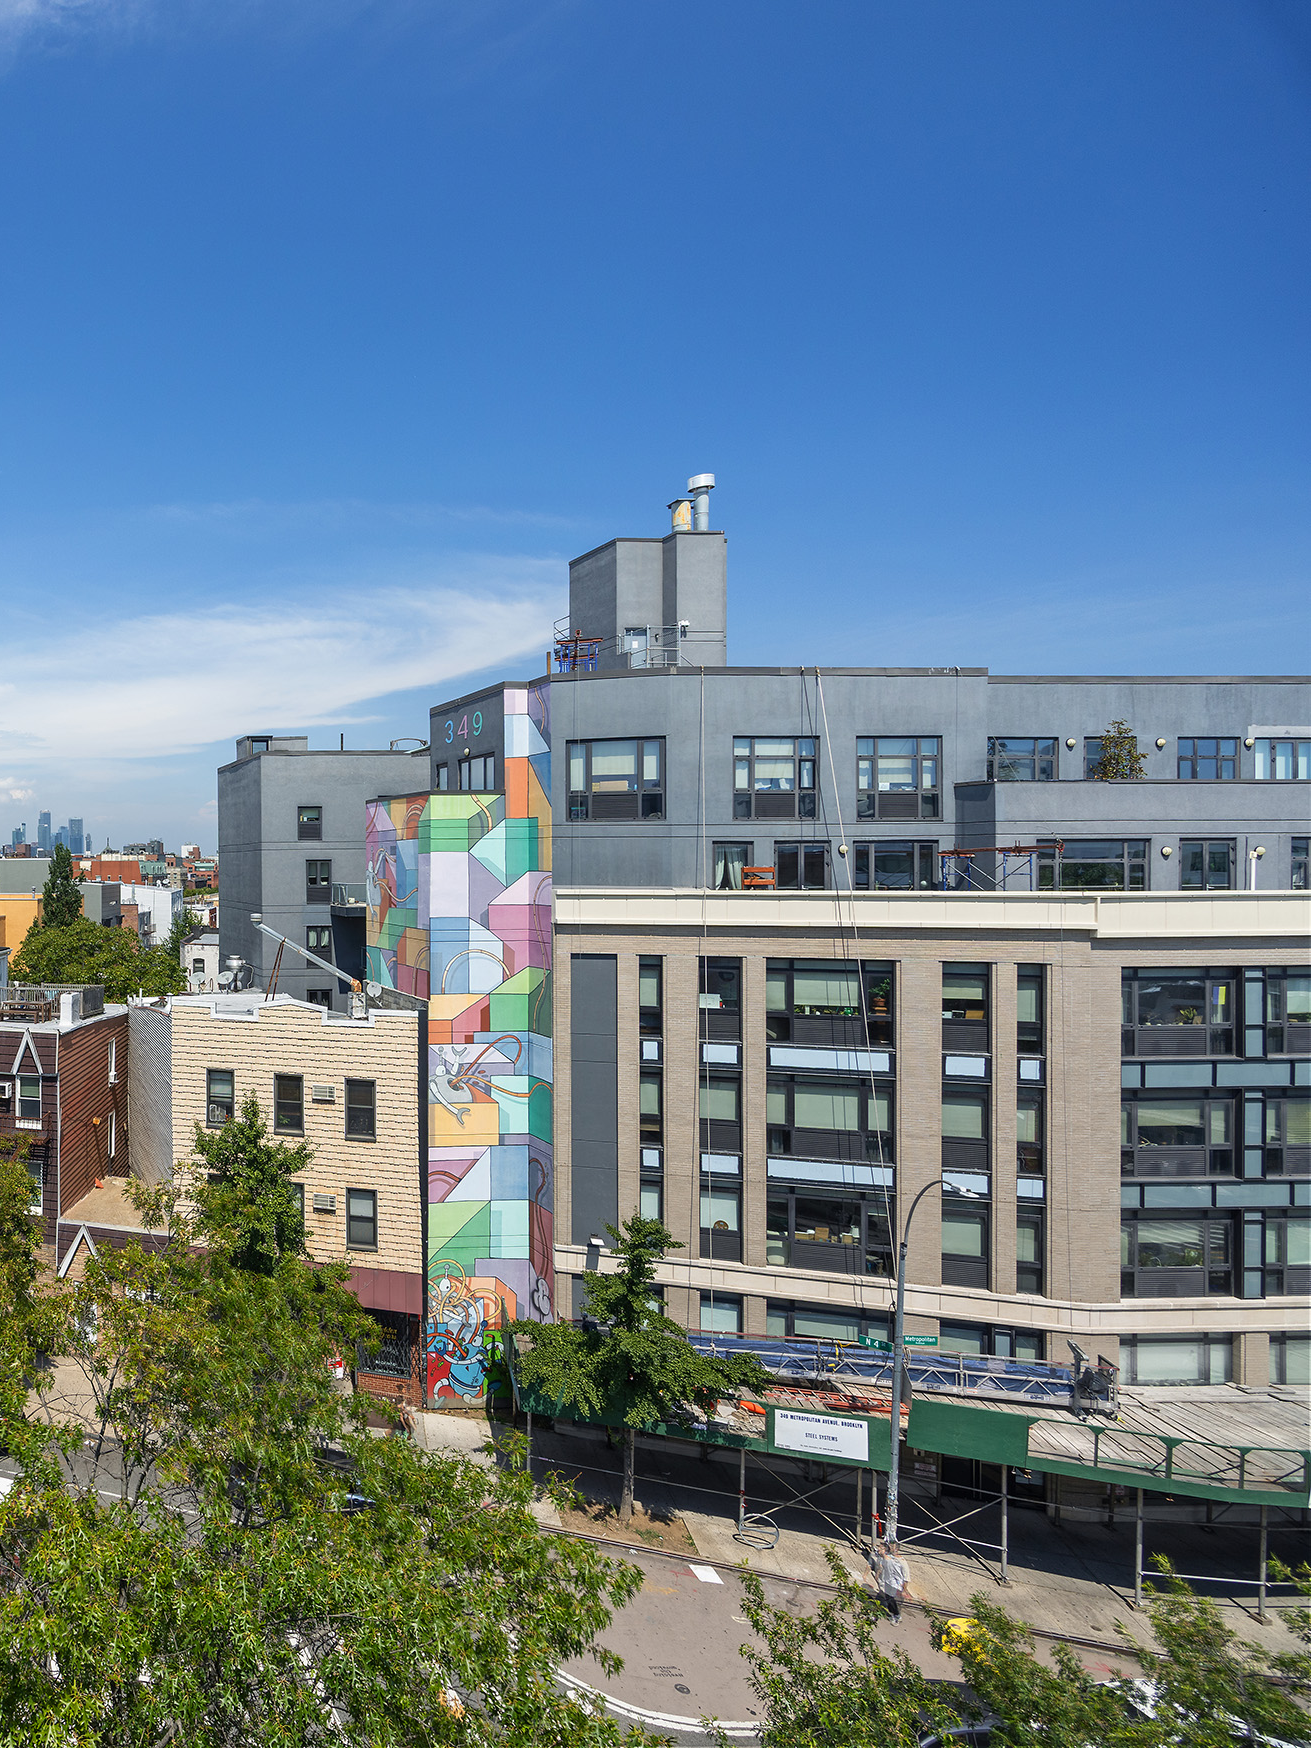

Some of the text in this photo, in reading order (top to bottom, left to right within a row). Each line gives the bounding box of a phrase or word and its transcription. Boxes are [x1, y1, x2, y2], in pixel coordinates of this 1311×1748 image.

[444, 711, 483, 744] 349
[866, 1337, 871, 1346] N
[873, 1340, 879, 1348] 4
[790, 1414, 821, 1423] METROPOLITAN
[841, 1421, 863, 1429] BROOKLYN
[819, 1434, 838, 1442] SYSTEMS
